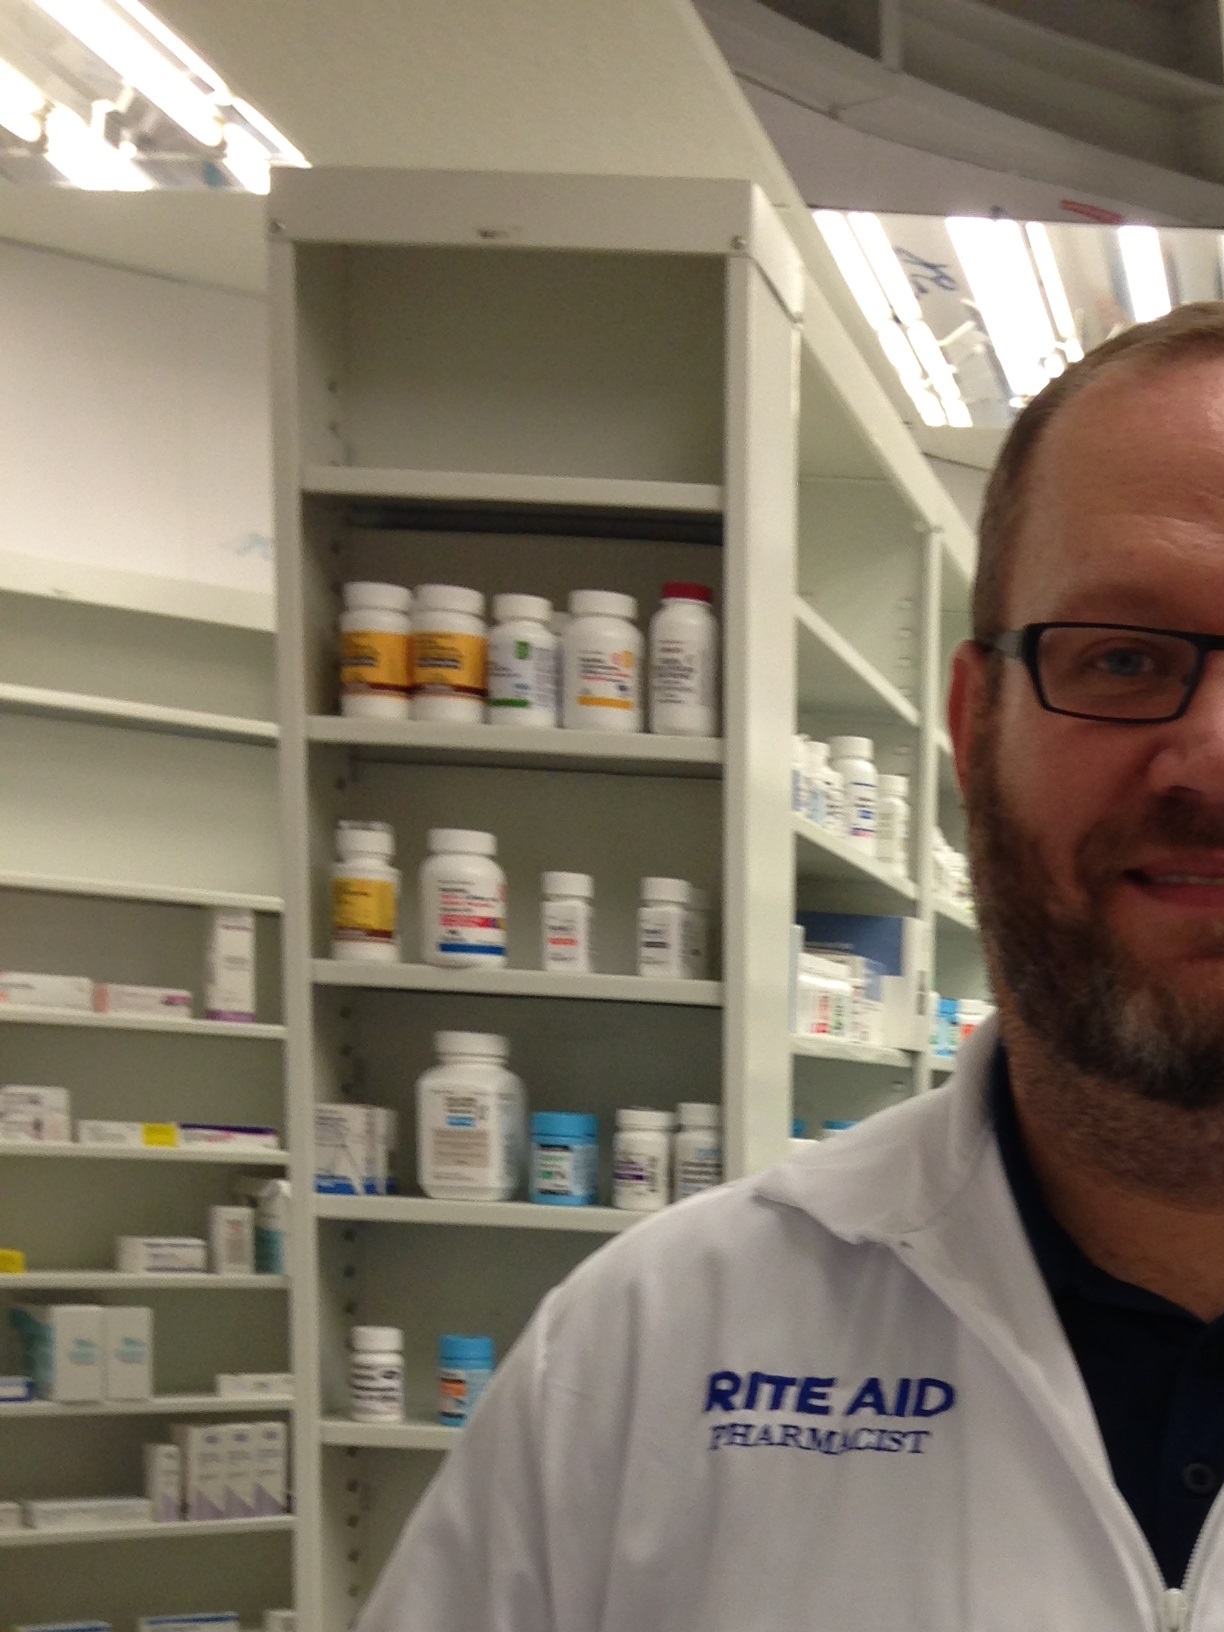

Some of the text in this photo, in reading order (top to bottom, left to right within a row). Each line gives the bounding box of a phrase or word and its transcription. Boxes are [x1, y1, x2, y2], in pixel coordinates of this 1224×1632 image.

[705, 1370, 957, 1417] RITE AID
[709, 1422, 931, 1455] PHARMACIST
